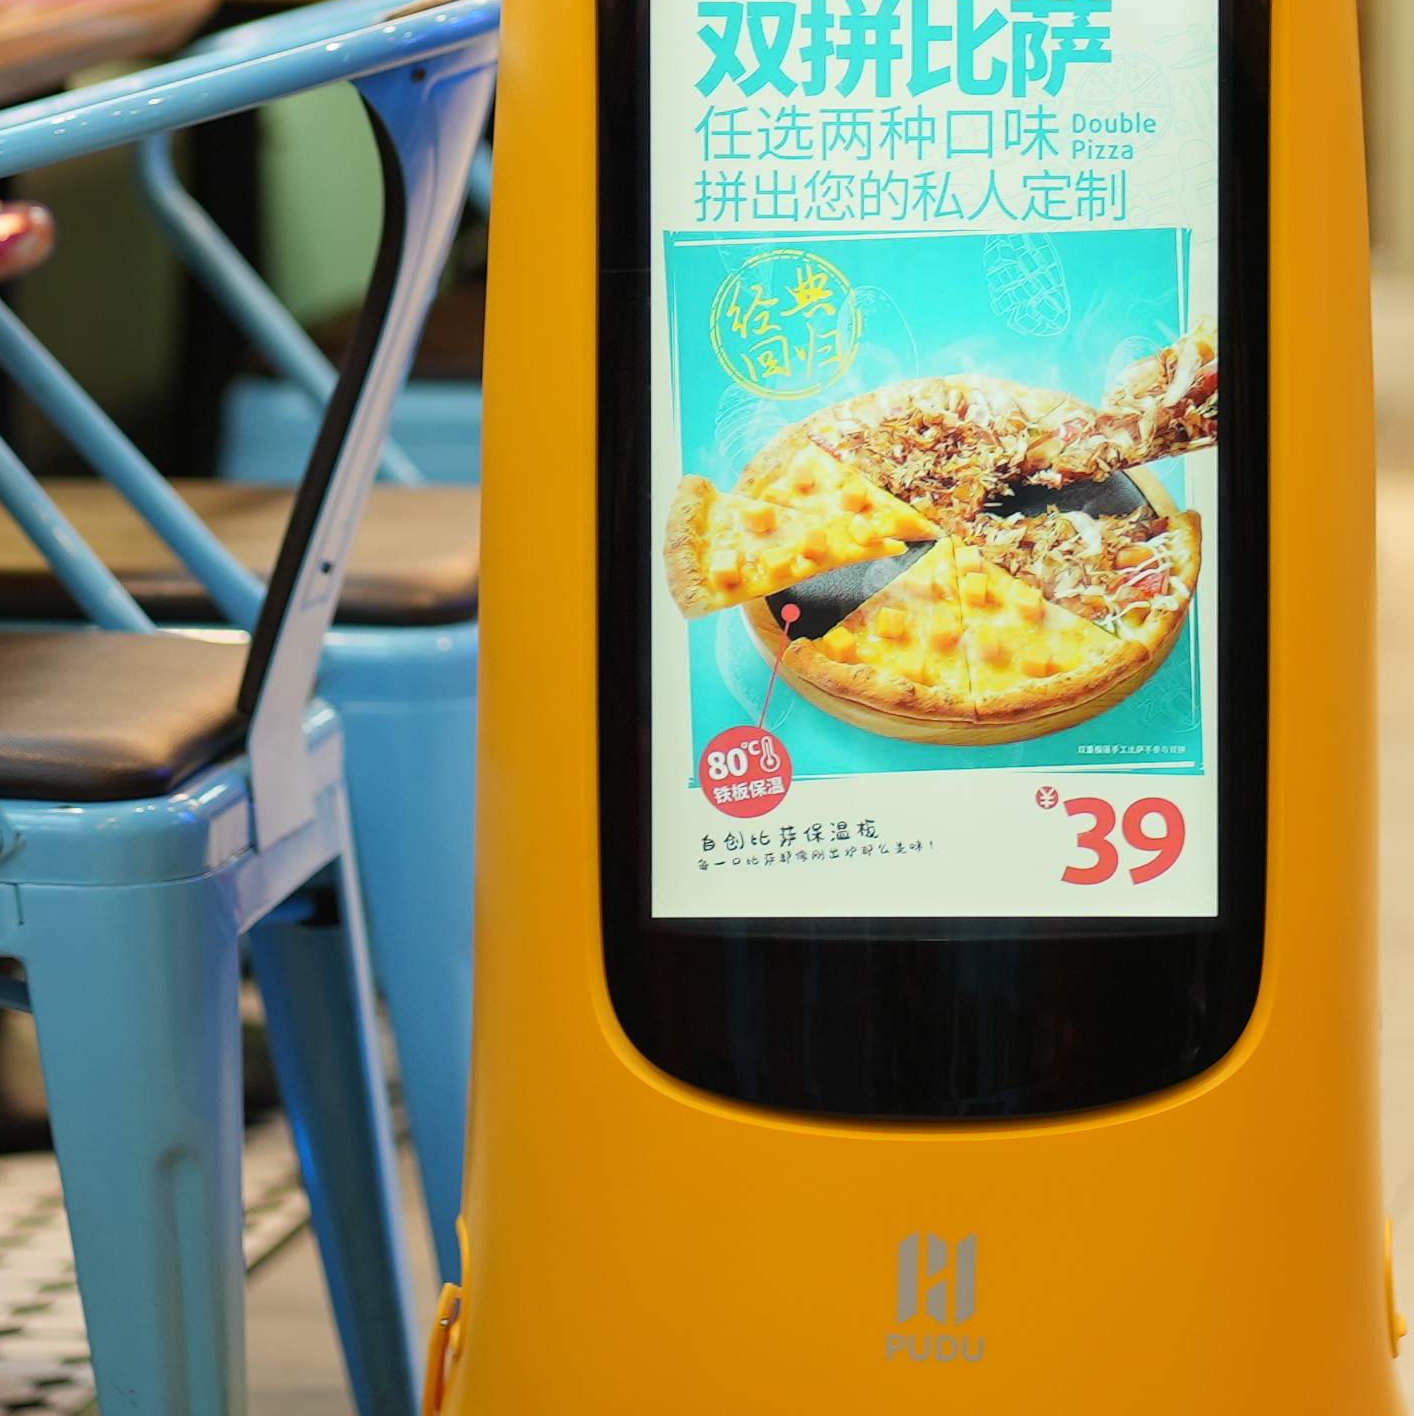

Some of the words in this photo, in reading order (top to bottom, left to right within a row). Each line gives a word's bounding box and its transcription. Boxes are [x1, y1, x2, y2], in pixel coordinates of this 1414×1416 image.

[693, 103, 1060, 161] 任选两种口味
[1071, 111, 1157, 134] Double
[1071, 139, 1135, 161] Pizza
[693, 169, 1128, 224] 拼出您的私人定制
[712, 775, 785, 805] 铁板保温
[885, 1332, 987, 1364] PUDU
